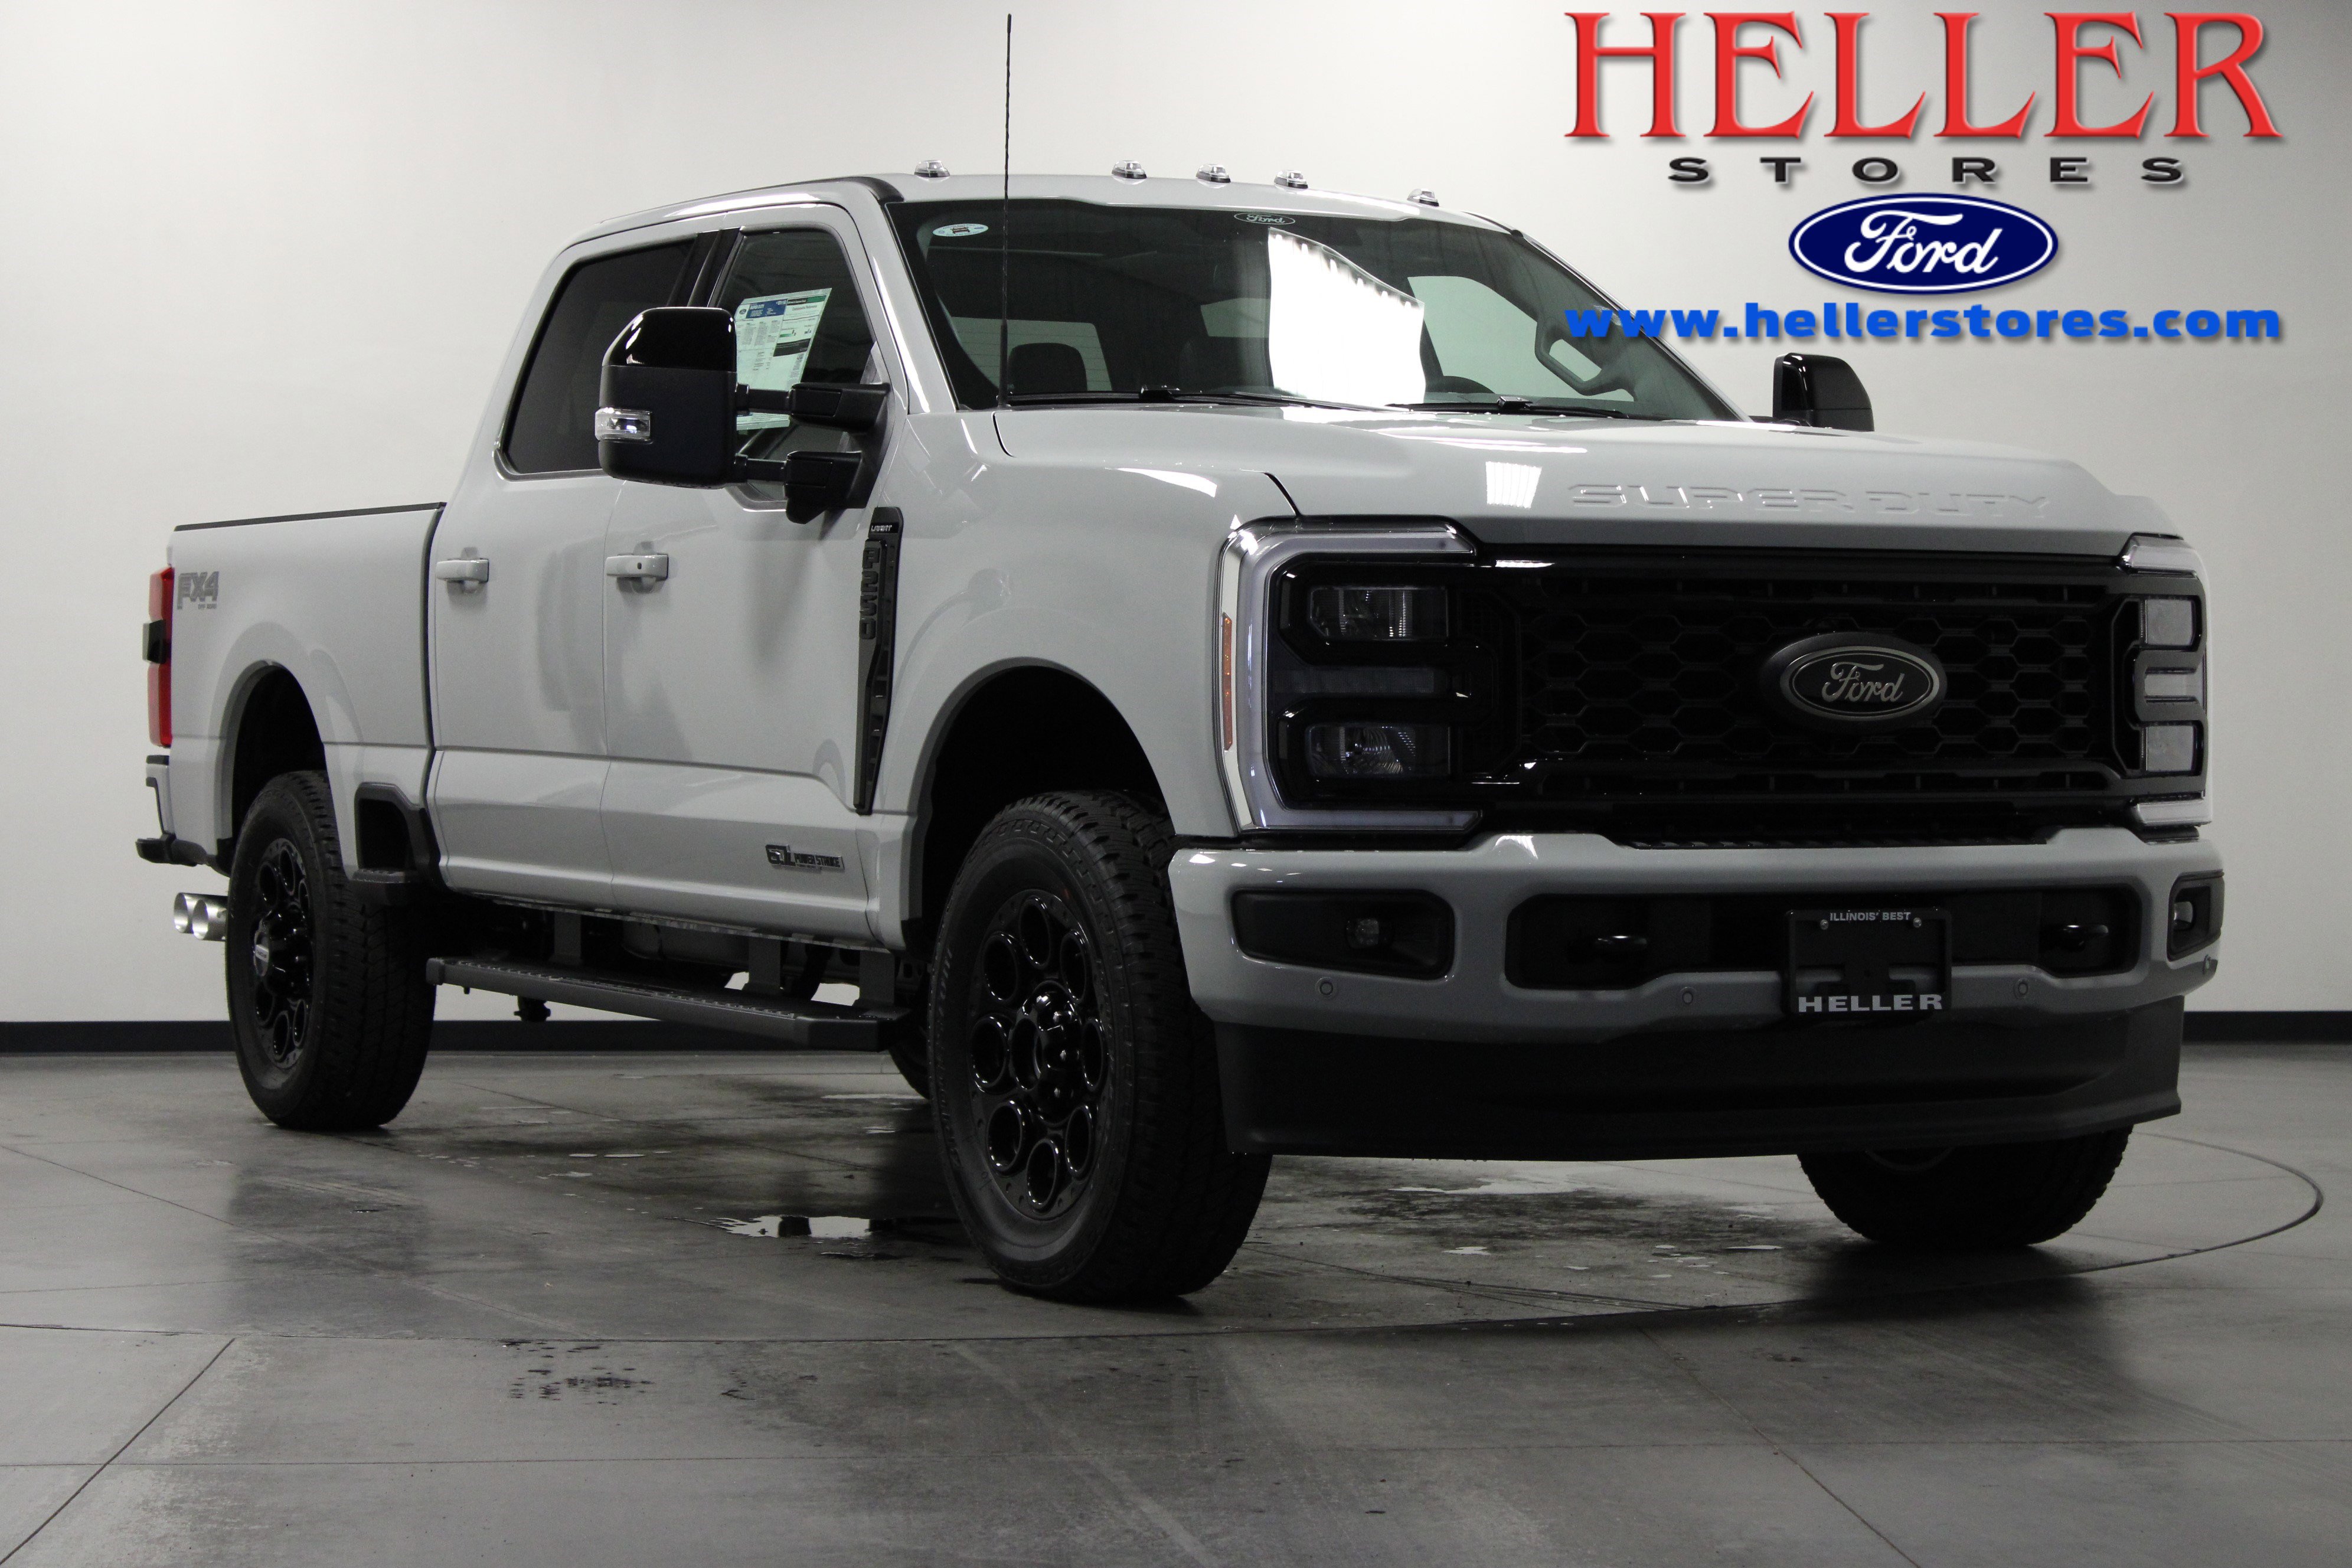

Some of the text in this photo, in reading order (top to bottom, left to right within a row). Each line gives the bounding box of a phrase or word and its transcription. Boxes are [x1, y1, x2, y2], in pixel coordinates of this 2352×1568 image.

[1246, 213, 1286, 224] Ford
[1568, 484, 2050, 518] SUPER DUTY
[177, 570, 219, 610] FX4
[1822, 661, 1905, 702] Ford
[1830, 912, 1911, 921] ILLINOIS' BEST
[1798, 994, 1942, 1012] HELLER
